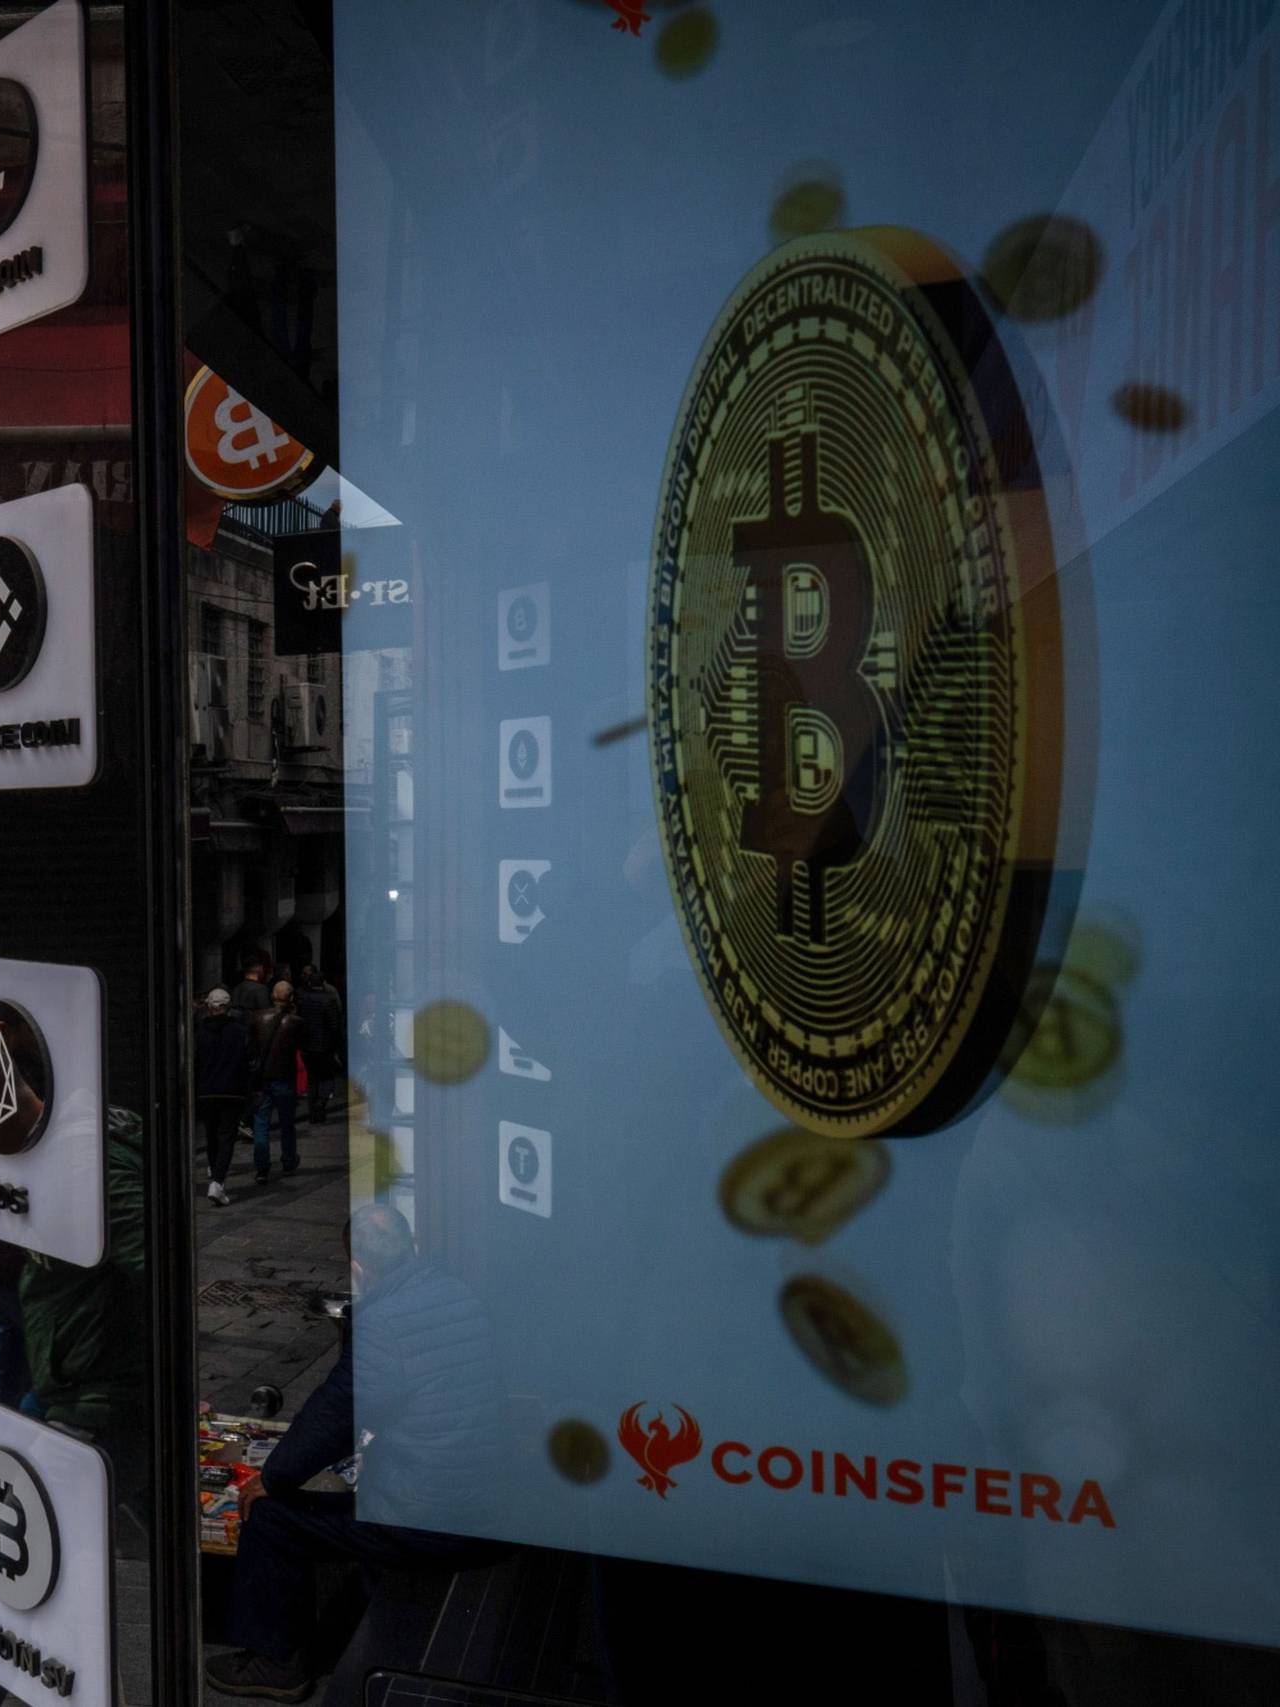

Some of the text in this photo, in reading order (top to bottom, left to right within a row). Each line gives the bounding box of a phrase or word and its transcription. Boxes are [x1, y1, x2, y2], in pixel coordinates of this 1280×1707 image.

[660, 460, 690, 601] BITCOIN
[688, 346, 739, 450] DIGITAL
[744, 276, 893, 346] DECENTRALIZED
[657, 622, 673, 771] METALS
[666, 791, 721, 977] MONETARY
[768, 1042, 836, 1098] COPPER
[711, 1441, 1116, 1529] COINSFERA
[41, 1657, 75, 1697] SV
